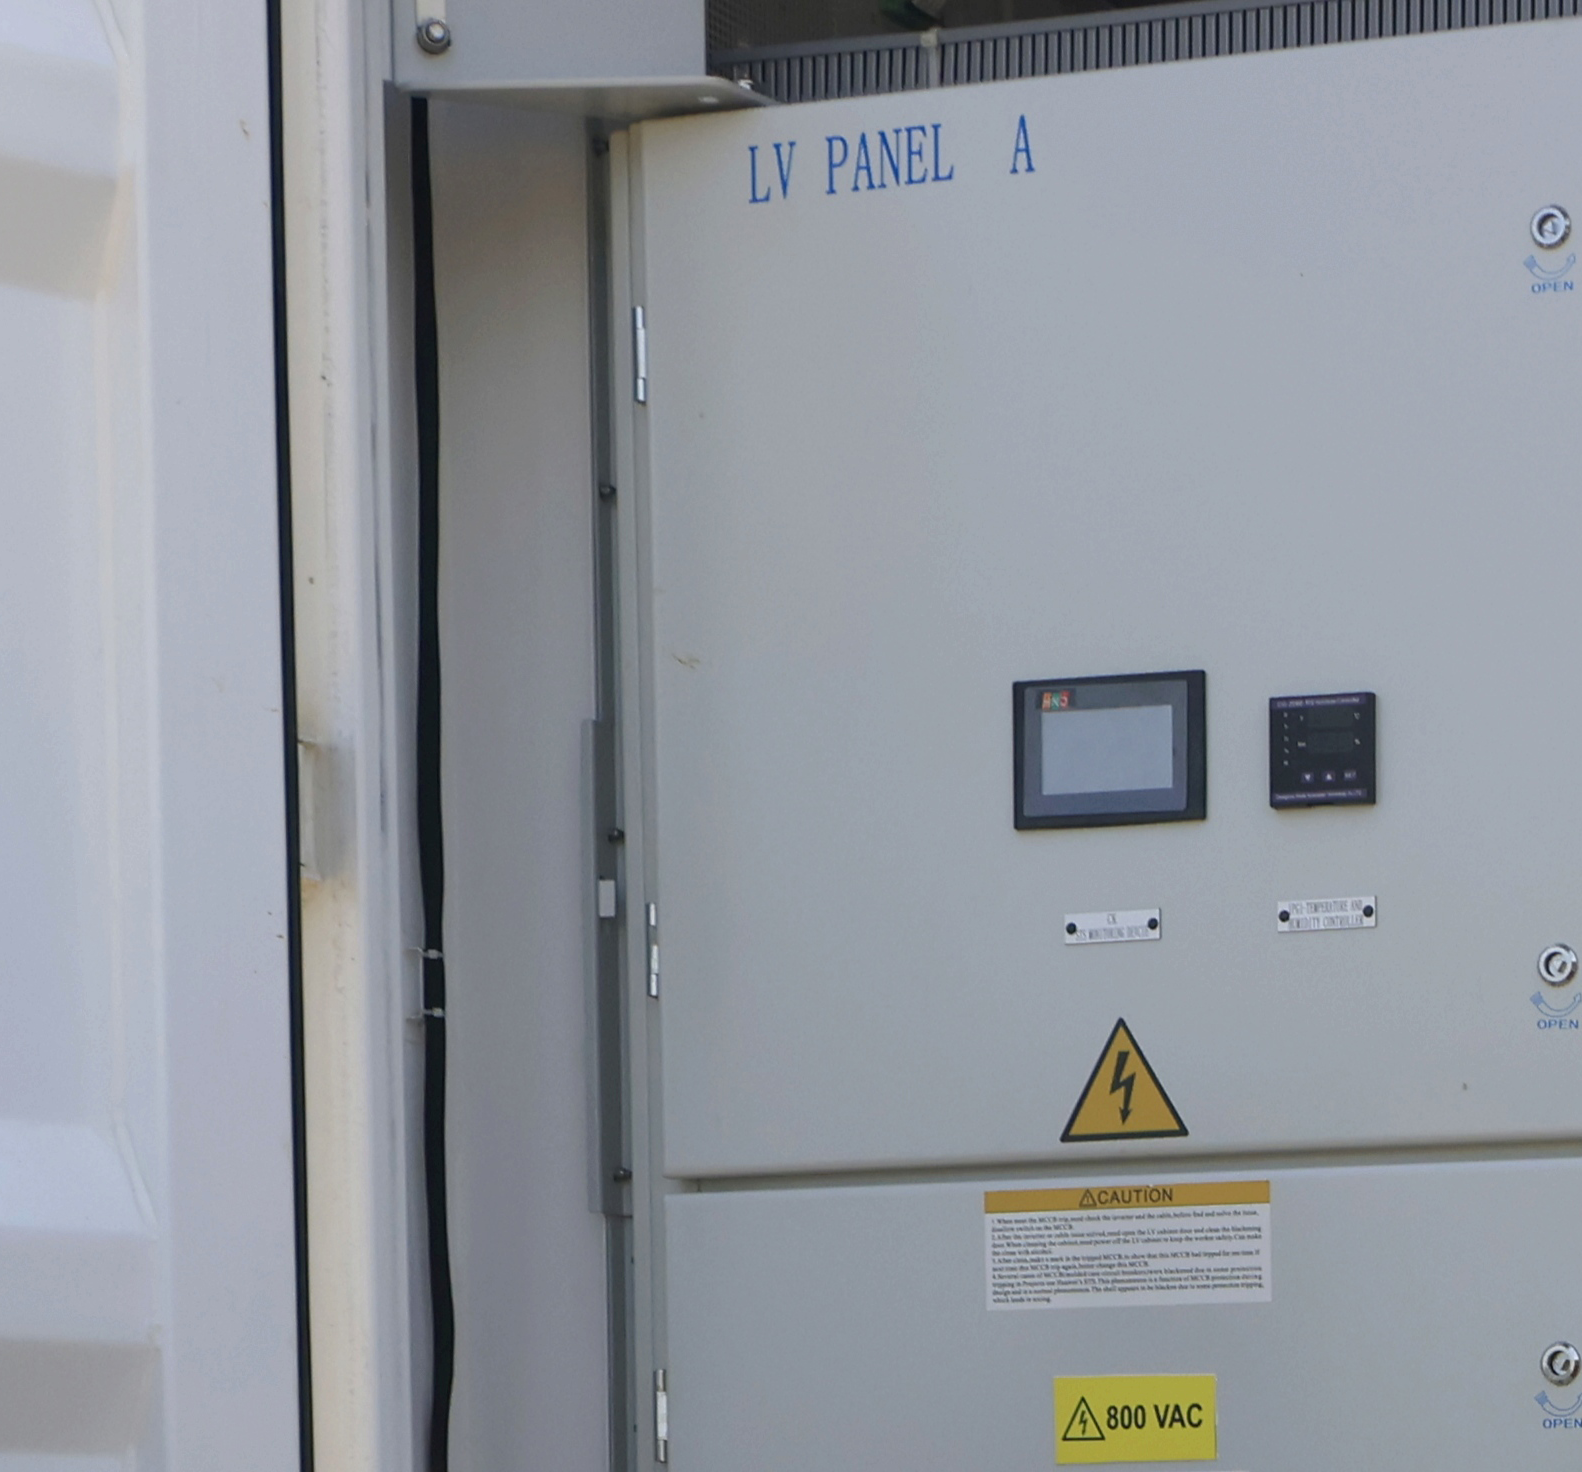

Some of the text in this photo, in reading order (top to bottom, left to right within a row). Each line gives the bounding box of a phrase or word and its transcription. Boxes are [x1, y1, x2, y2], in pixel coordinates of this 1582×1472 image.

[748, 114, 1036, 203] LV PANEL A
[1530, 279, 1574, 294] OPEN
[1537, 1018, 1579, 1031] OPEN
[1097, 1187, 1174, 1205] CAUTION
[1106, 1403, 1203, 1430] 800 VAC
